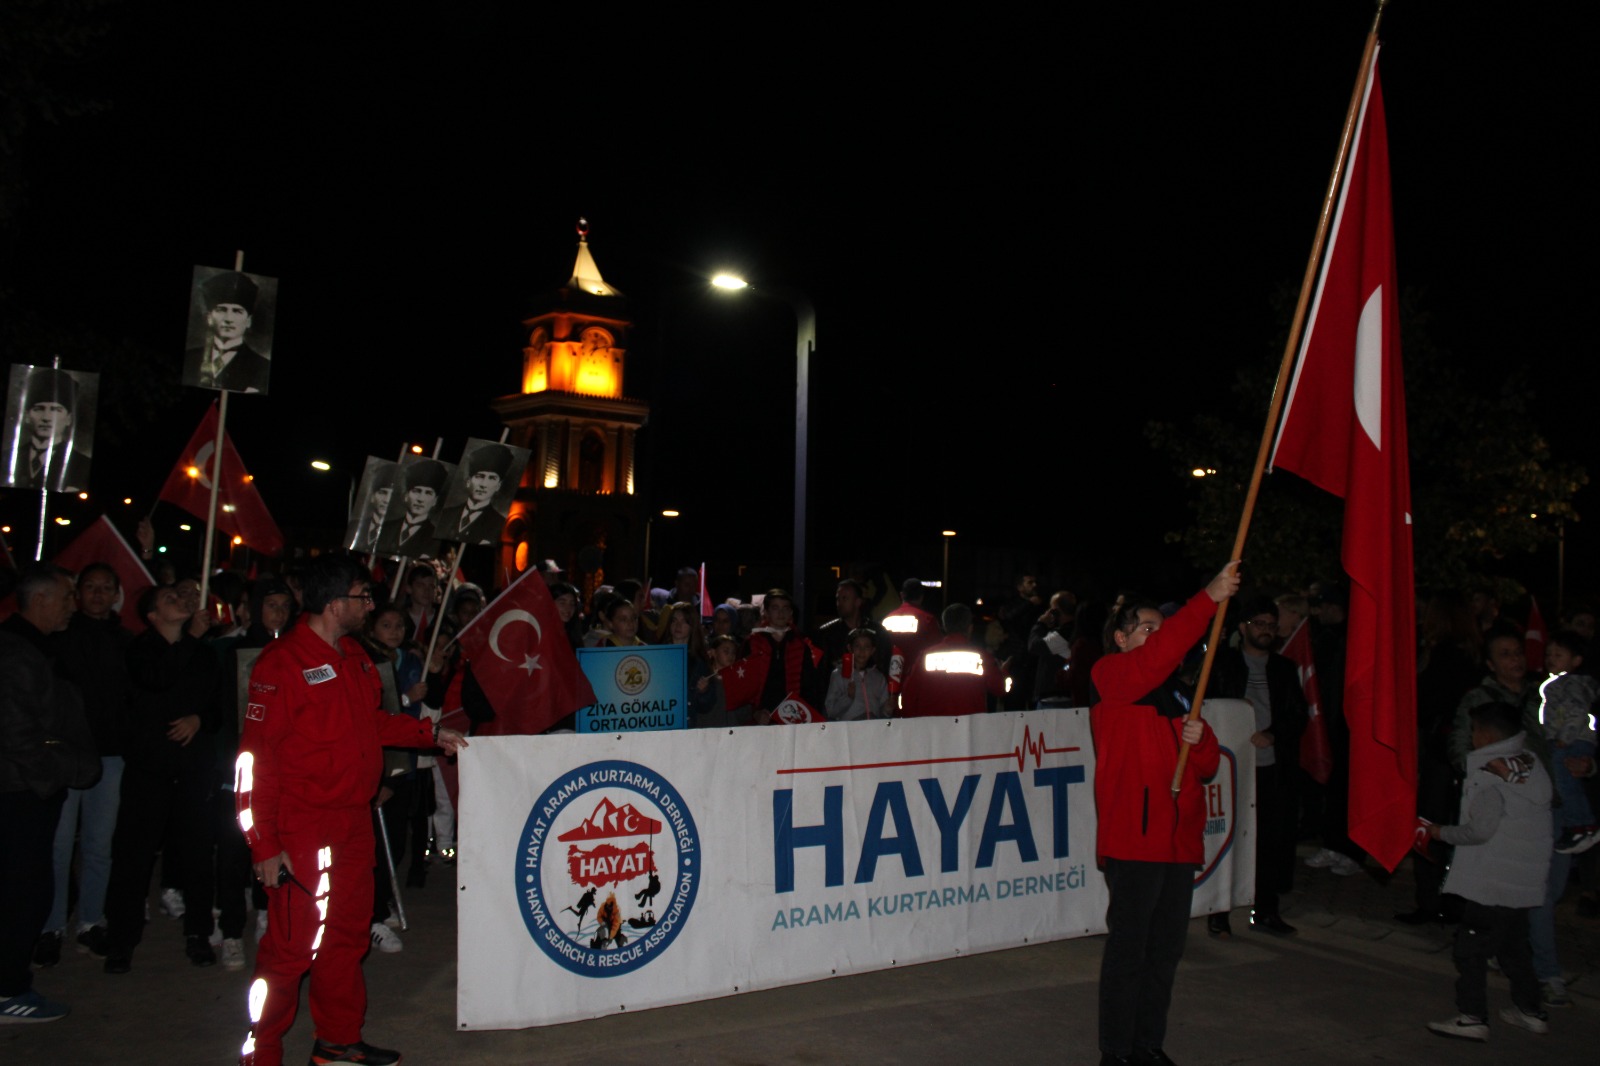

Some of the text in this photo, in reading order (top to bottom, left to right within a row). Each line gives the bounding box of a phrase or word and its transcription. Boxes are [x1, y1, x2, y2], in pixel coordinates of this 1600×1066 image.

[305, 668, 330, 682] HAYAT
[589, 714, 675, 732] ORTAOKULU
[621, 699, 678, 715] GÖKALP
[1208, 784, 1225, 818] EL
[526, 769, 694, 868] HAYAT ARAMA KURTARMA DERNEĞİ
[773, 765, 1085, 894] HAYAT
[580, 852, 647, 878] HAYAT
[771, 864, 1086, 931] ARAMA KURTARMA DERNEĞİ
[526, 872, 693, 967] HAYAT SEARCH & RESCUE ASSOCIATION
